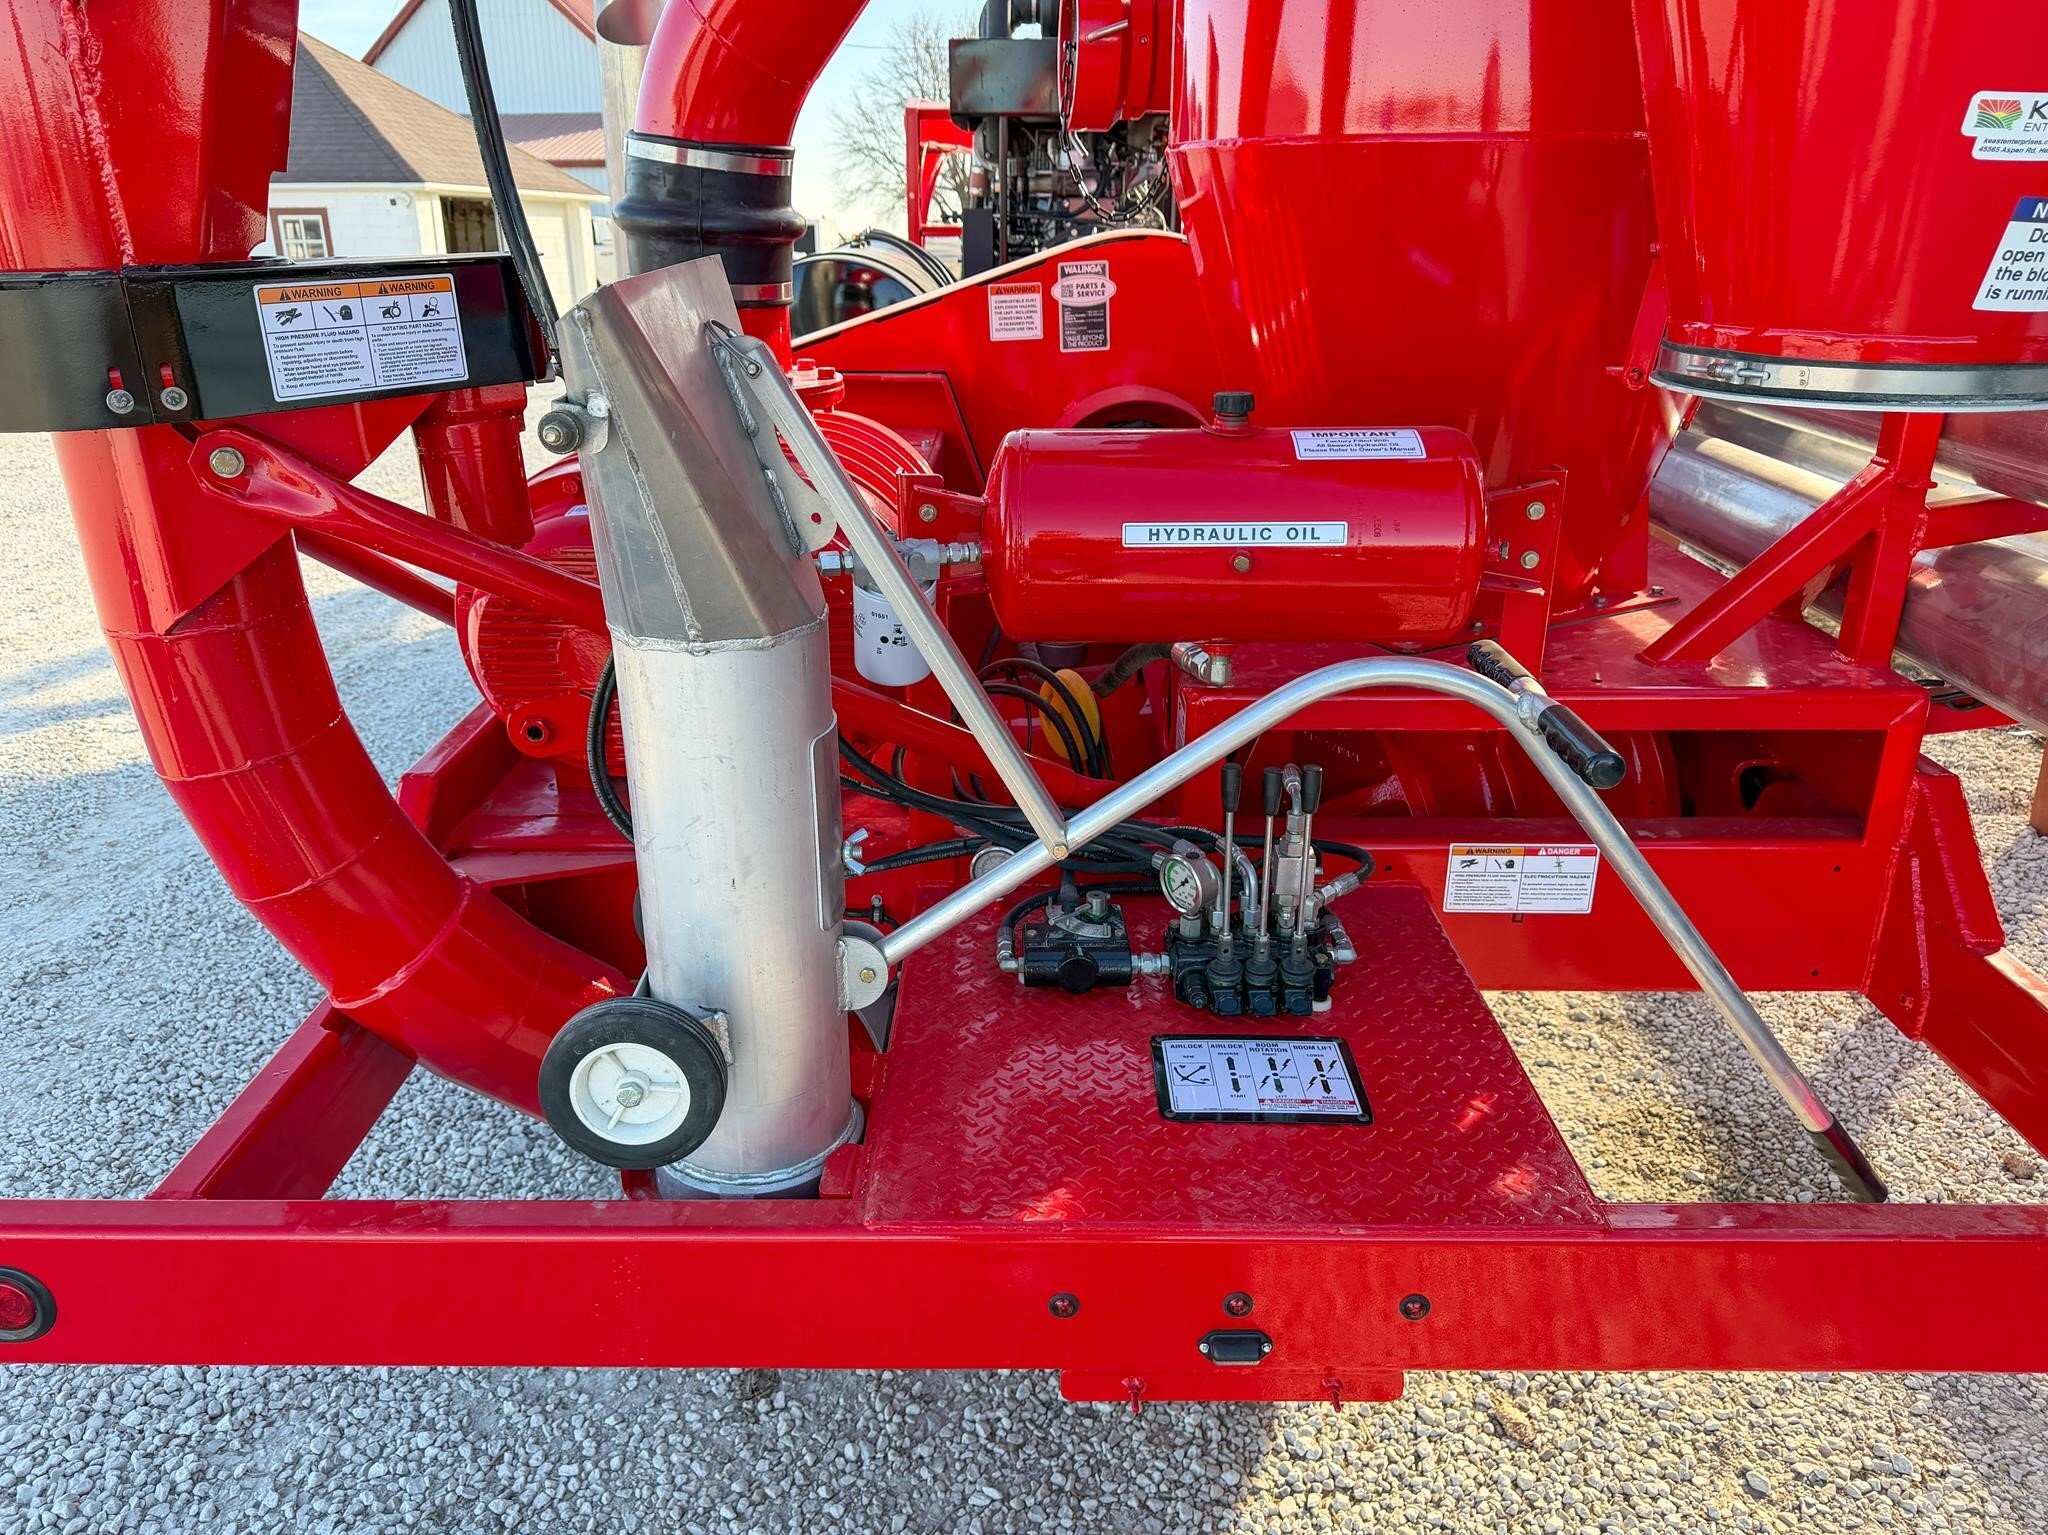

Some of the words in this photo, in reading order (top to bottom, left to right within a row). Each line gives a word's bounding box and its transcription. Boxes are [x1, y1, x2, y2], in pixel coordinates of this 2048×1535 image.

[2023, 122, 2048, 132] ENT
[2032, 202, 2048, 218] N
[2002, 250, 2045, 265] open
[1995, 266, 2023, 281] the
[291, 287, 342, 299] WARNING
[389, 281, 435, 292] WARNING
[1003, 286, 1035, 294] WARNING
[1985, 285, 2002, 299] is
[2005, 287, 2048, 300] runni
[1149, 527, 1272, 541] HYDRAULIC
[1286, 527, 1321, 541] OIL
